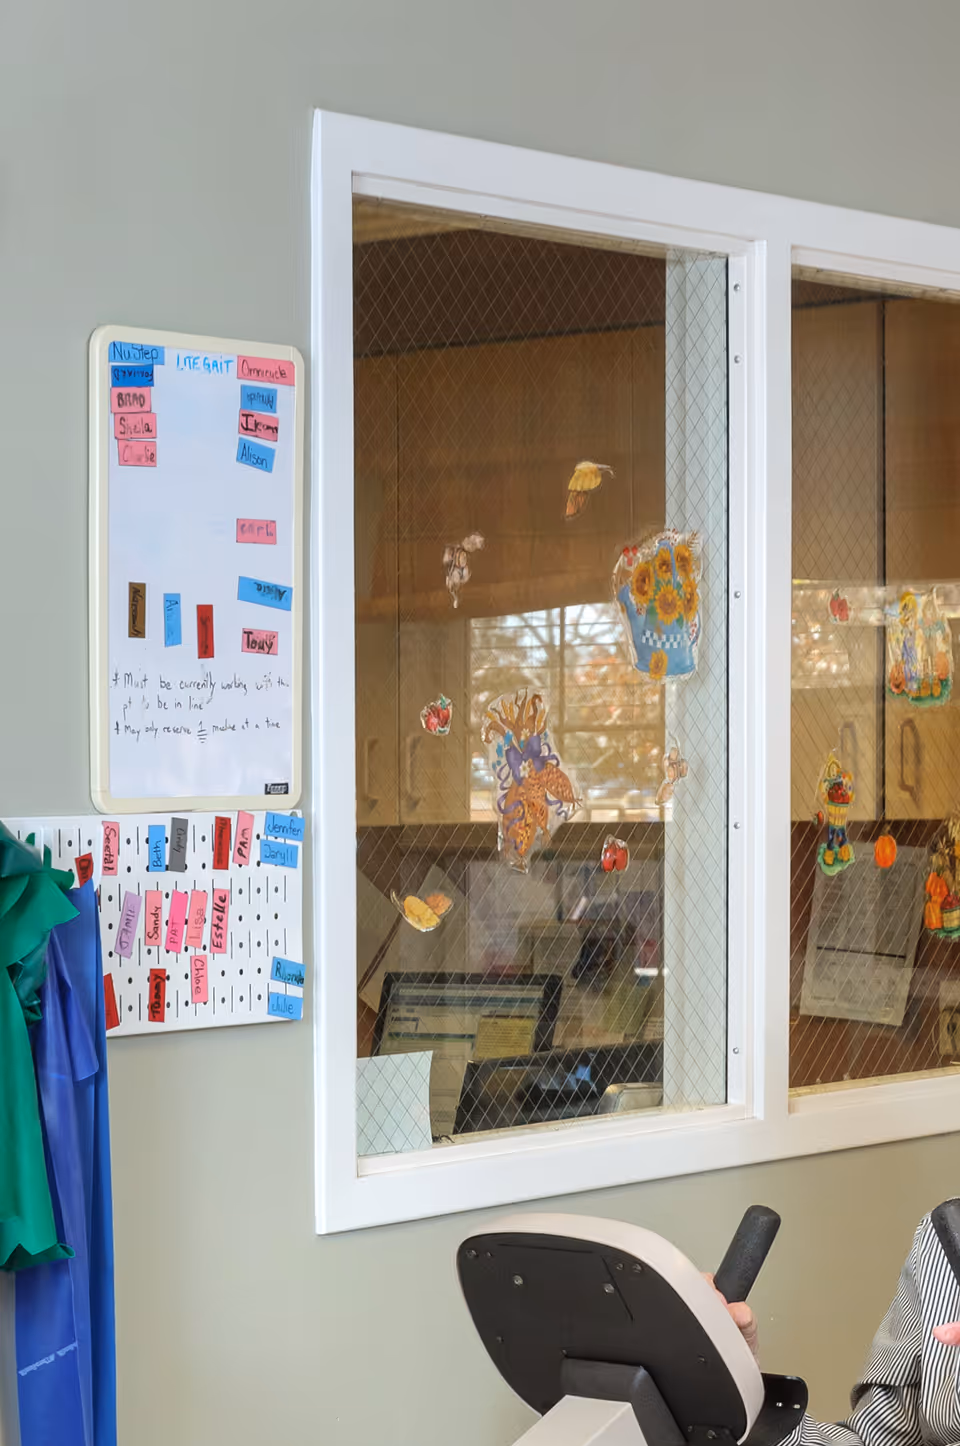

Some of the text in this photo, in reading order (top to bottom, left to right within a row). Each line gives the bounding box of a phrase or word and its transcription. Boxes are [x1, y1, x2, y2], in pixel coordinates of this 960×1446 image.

[240, 443, 268, 468] Alison
[124, 672, 148, 689] Must
[159, 673, 173, 690] be
[277, 676, 289, 687] th
[157, 694, 168, 710] be
[174, 698, 182, 709] in
[267, 815, 302, 836] Jennifer
[152, 840, 162, 868] Beth
[147, 905, 162, 940] Sandy
[212, 893, 228, 949] Estelle
[272, 995, 294, 1015] Julie
